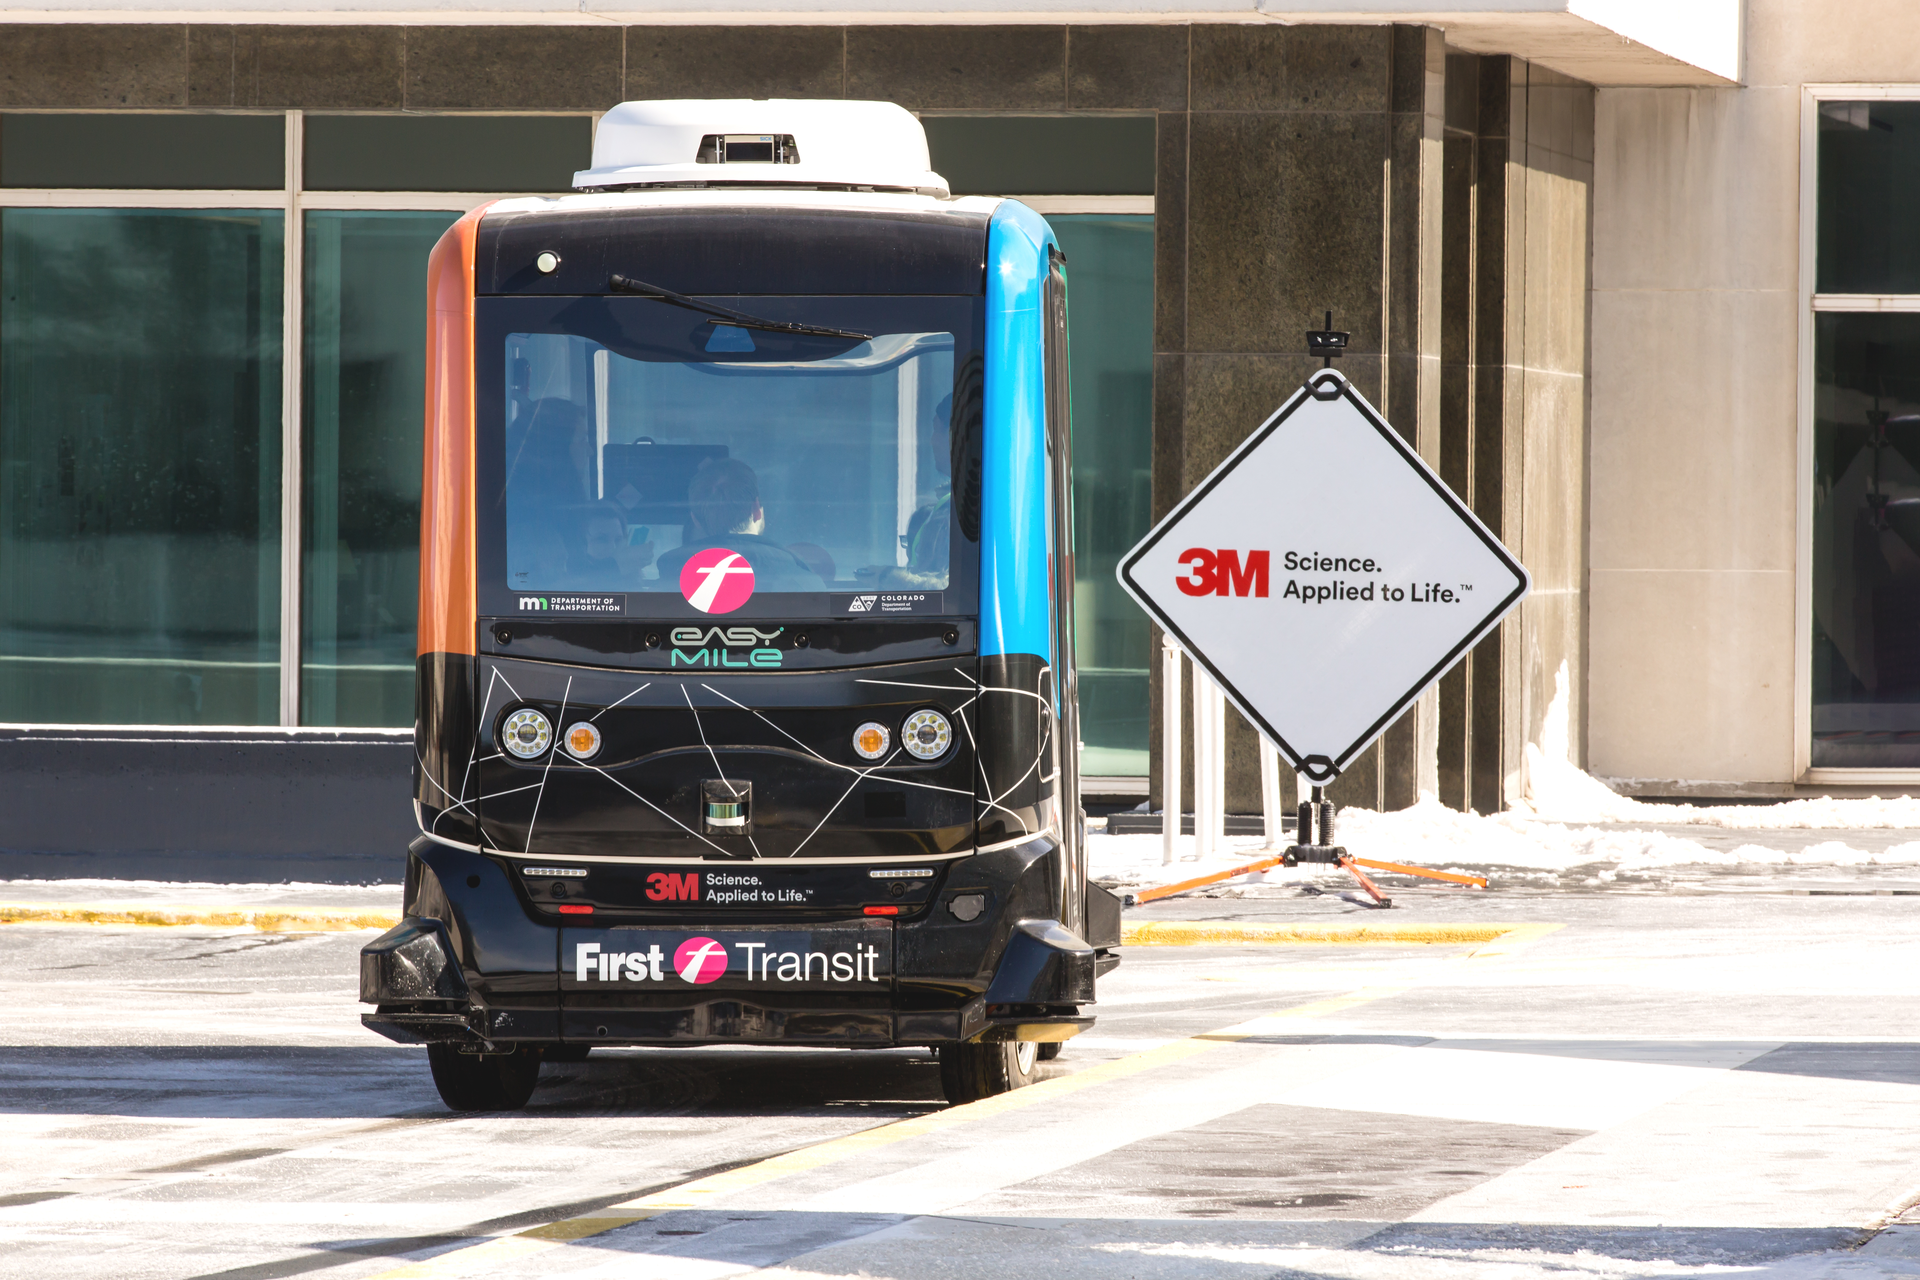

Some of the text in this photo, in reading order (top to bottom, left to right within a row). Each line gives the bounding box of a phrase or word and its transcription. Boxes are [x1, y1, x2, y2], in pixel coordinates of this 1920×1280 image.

[1175, 547, 1271, 598] 3M
[1284, 551, 1382, 572] Science.
[1283, 580, 1374, 604] Applied
[1382, 584, 1405, 602] to
[645, 872, 699, 901] 3M
[706, 873, 763, 886] Science.
[706, 889, 758, 903] Applied
[761, 890, 776, 902] to
[576, 942, 664, 982] First
[735, 942, 879, 982] Transit
